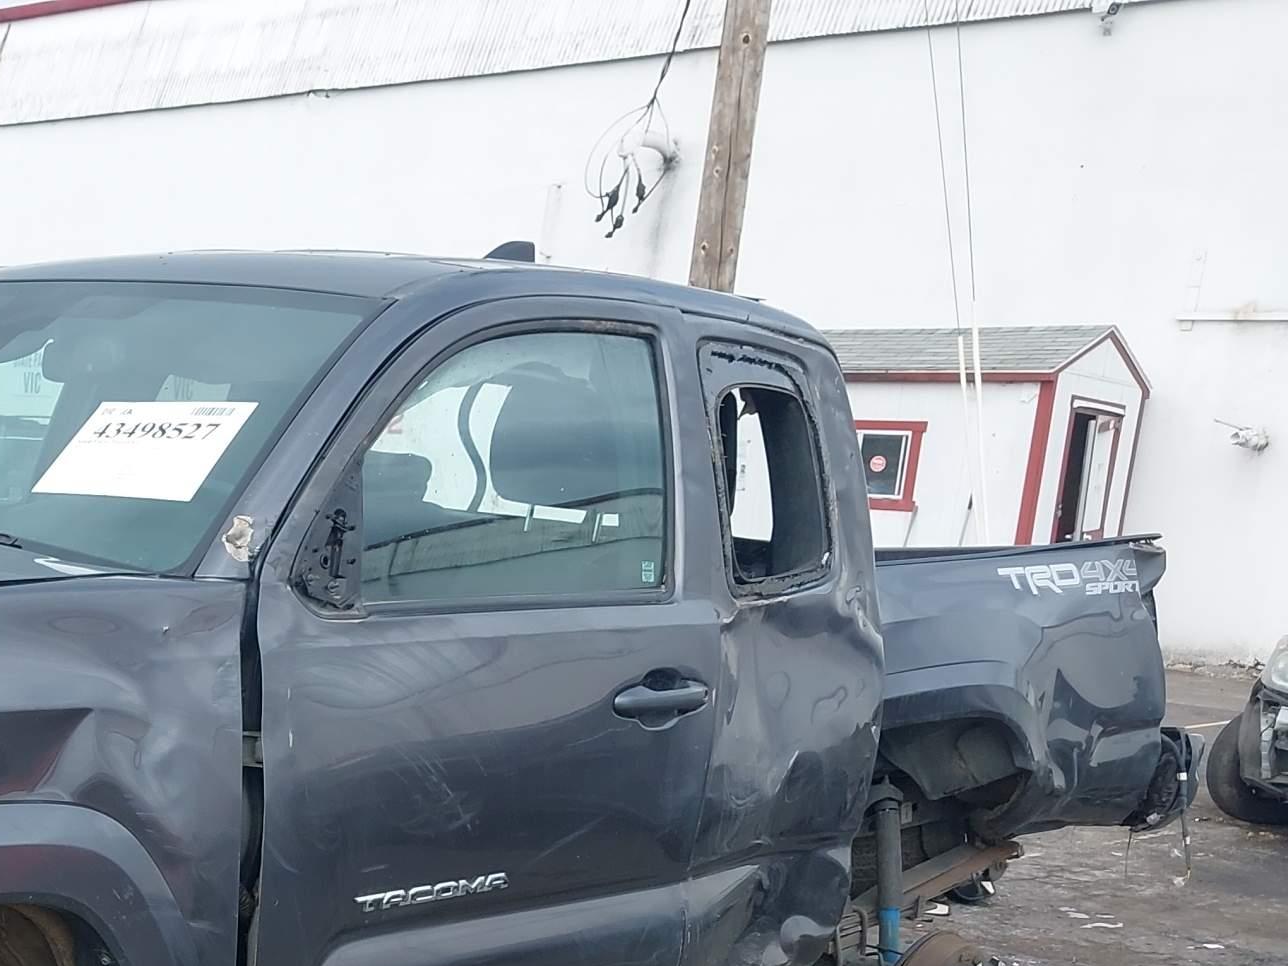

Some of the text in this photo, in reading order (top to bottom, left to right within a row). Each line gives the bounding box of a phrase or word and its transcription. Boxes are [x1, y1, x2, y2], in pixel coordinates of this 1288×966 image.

[93, 422, 221, 440] 43498527
[997, 562, 1081, 596] TRD
[1085, 580, 1140, 596] SPORT
[353, 871, 510, 912] TACOMA
